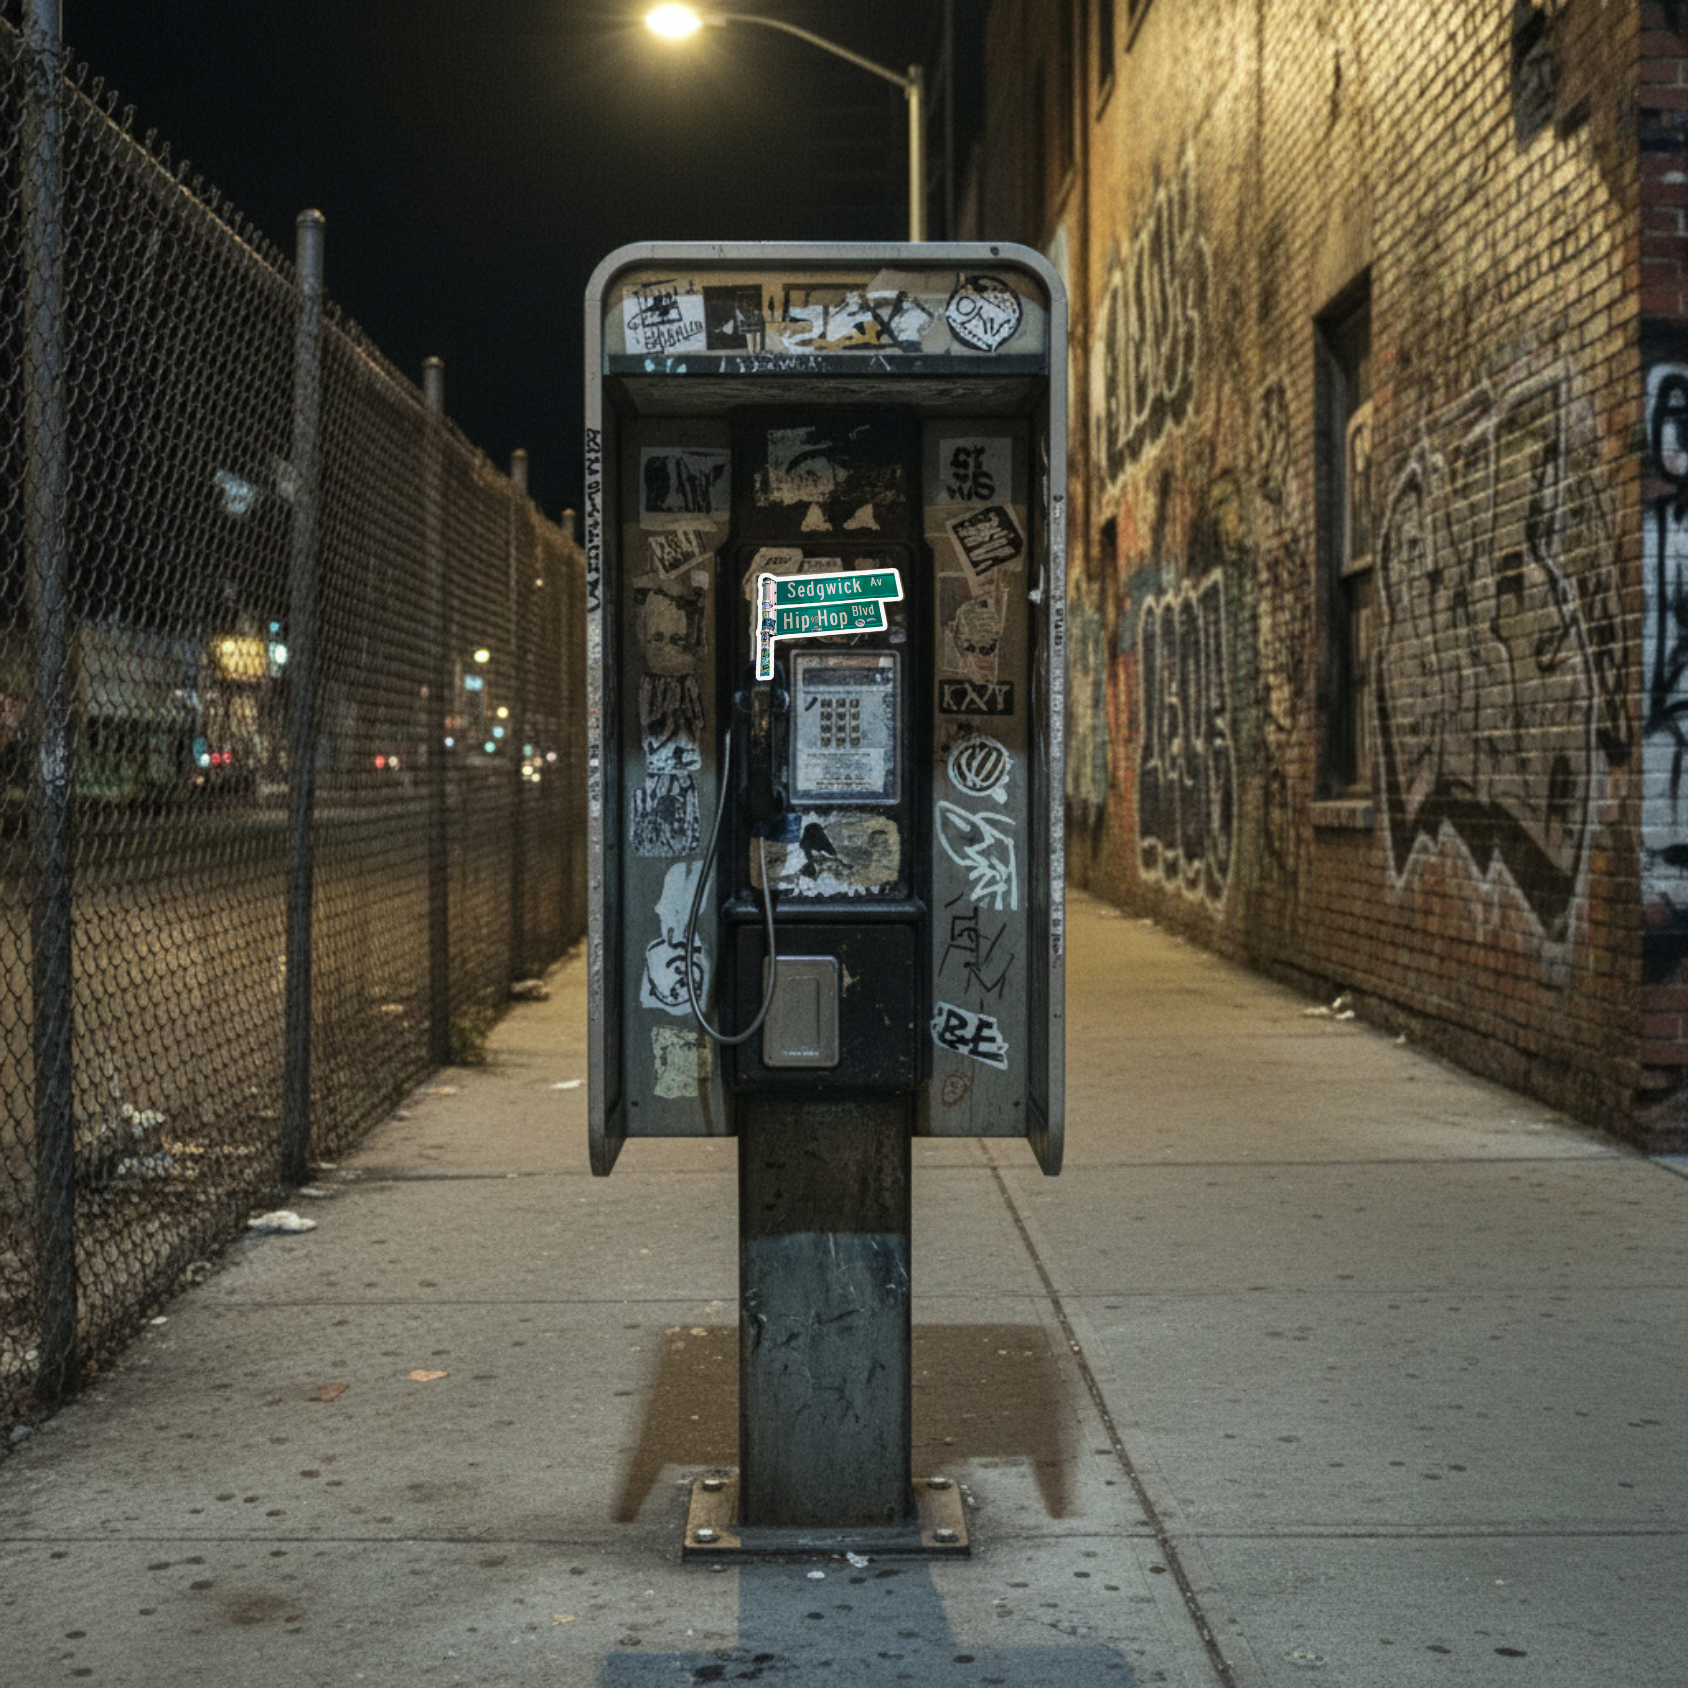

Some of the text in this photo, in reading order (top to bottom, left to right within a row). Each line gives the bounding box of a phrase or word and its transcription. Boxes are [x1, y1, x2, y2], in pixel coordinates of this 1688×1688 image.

[787, 576, 882, 600] Sedgwick Av
[783, 611, 810, 632] Hip
[817, 609, 848, 629] Hop
[852, 604, 875, 617] Blvd
